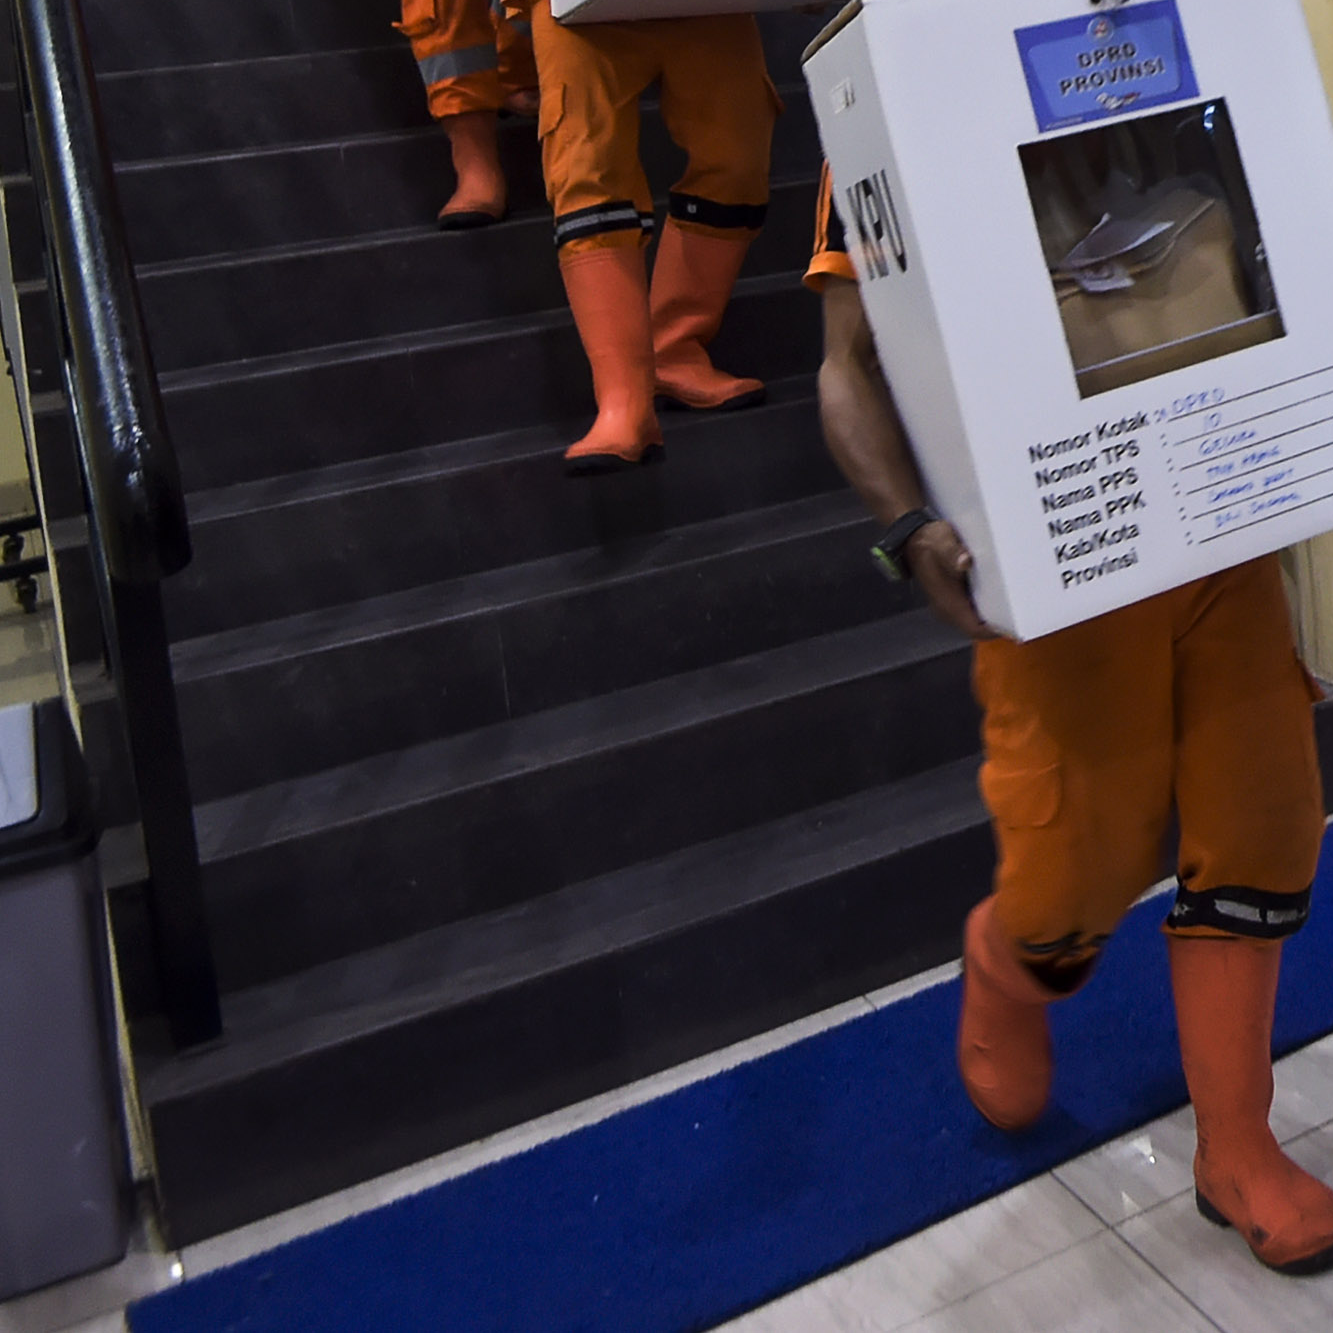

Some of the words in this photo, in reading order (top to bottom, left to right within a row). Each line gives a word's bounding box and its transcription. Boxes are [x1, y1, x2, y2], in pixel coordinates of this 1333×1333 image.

[1059, 57, 1165, 96] PROVINSI
[1077, 41, 1138, 70] DPRD
[845, 168, 908, 282] KPU
[1028, 431, 1092, 464] Nomor
[1095, 411, 1150, 442] Kotak
[1035, 456, 1098, 489] Nomor
[1101, 439, 1141, 466] TPS
[1041, 485, 1096, 514] Nama
[1099, 467, 1139, 495] PPS
[1048, 509, 1102, 539] Nama
[1105, 490, 1147, 520] PPK
[1054, 523, 1140, 565] Kab/Kota
[1060, 547, 1139, 590] Provinsi
